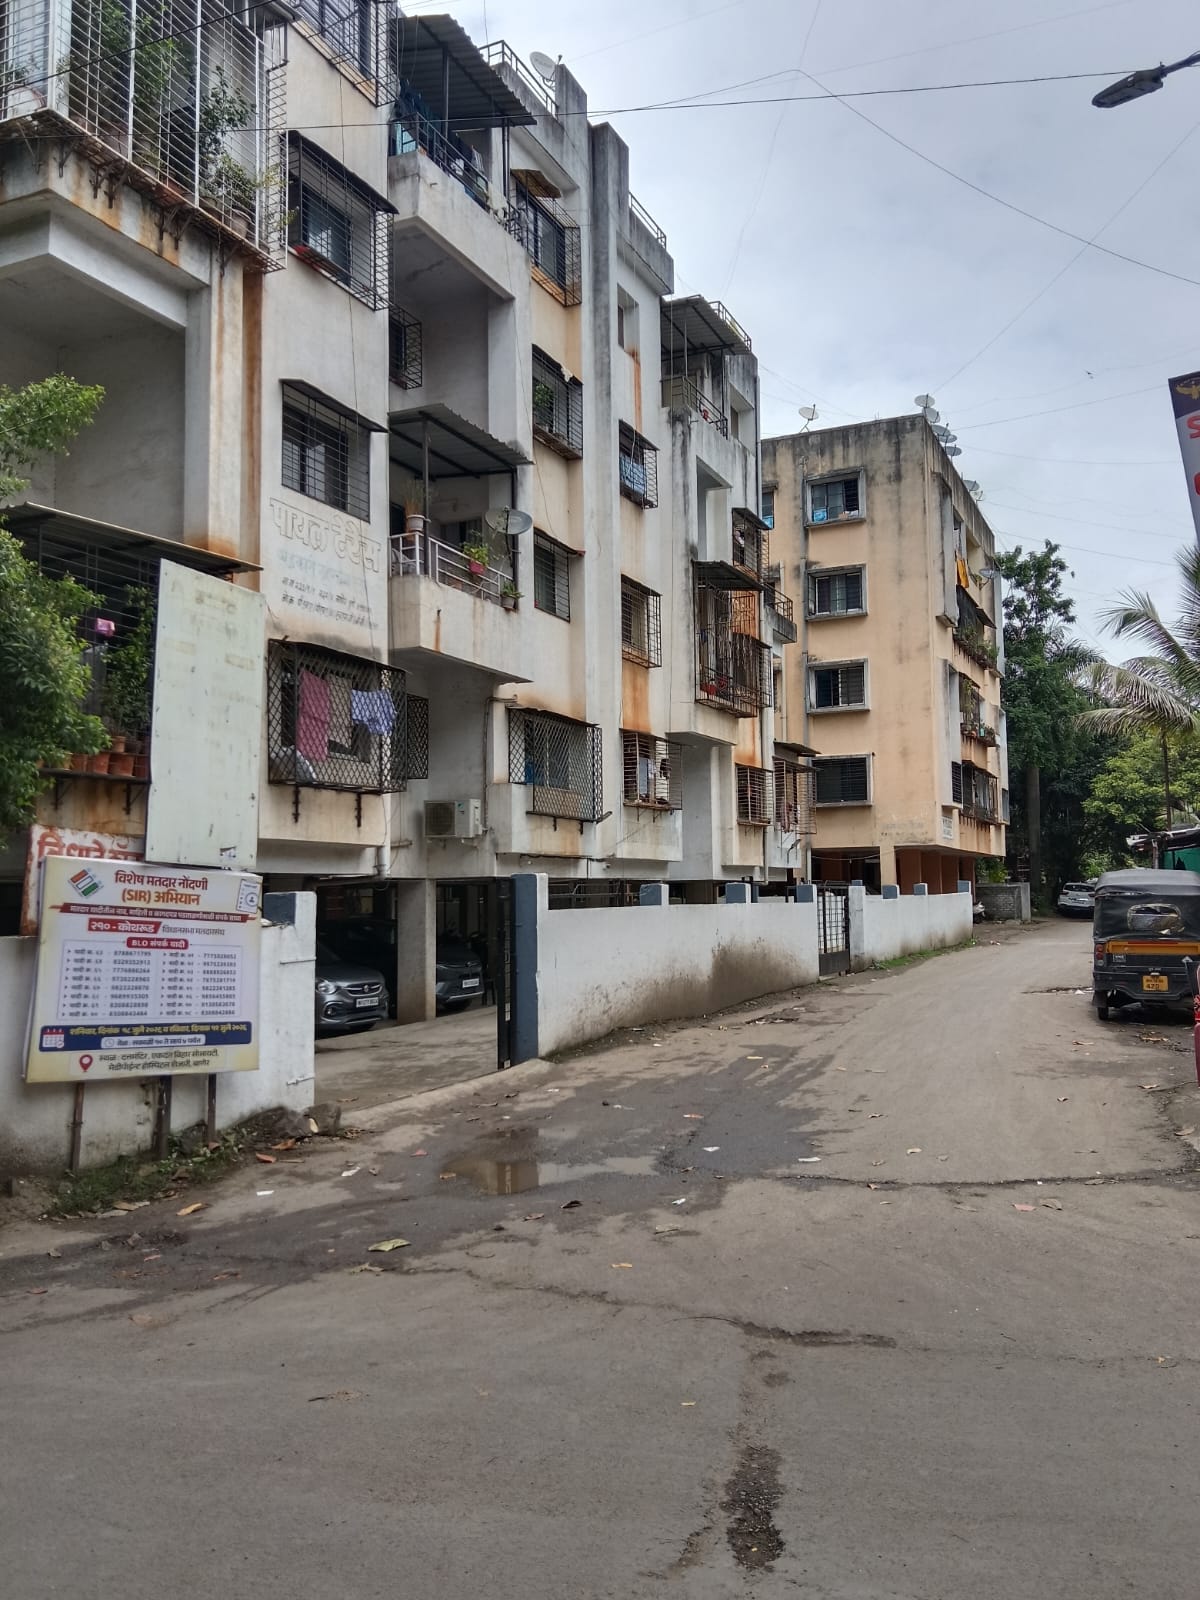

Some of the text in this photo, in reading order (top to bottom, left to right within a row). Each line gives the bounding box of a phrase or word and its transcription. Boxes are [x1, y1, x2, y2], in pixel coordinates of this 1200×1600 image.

[270, 497, 329, 552] पायल
[115, 870, 208, 891] विशेष मतदार नोंदणी
[122, 888, 201, 905] (SIR) अभियान
[131, 939, 148, 947] BLO
